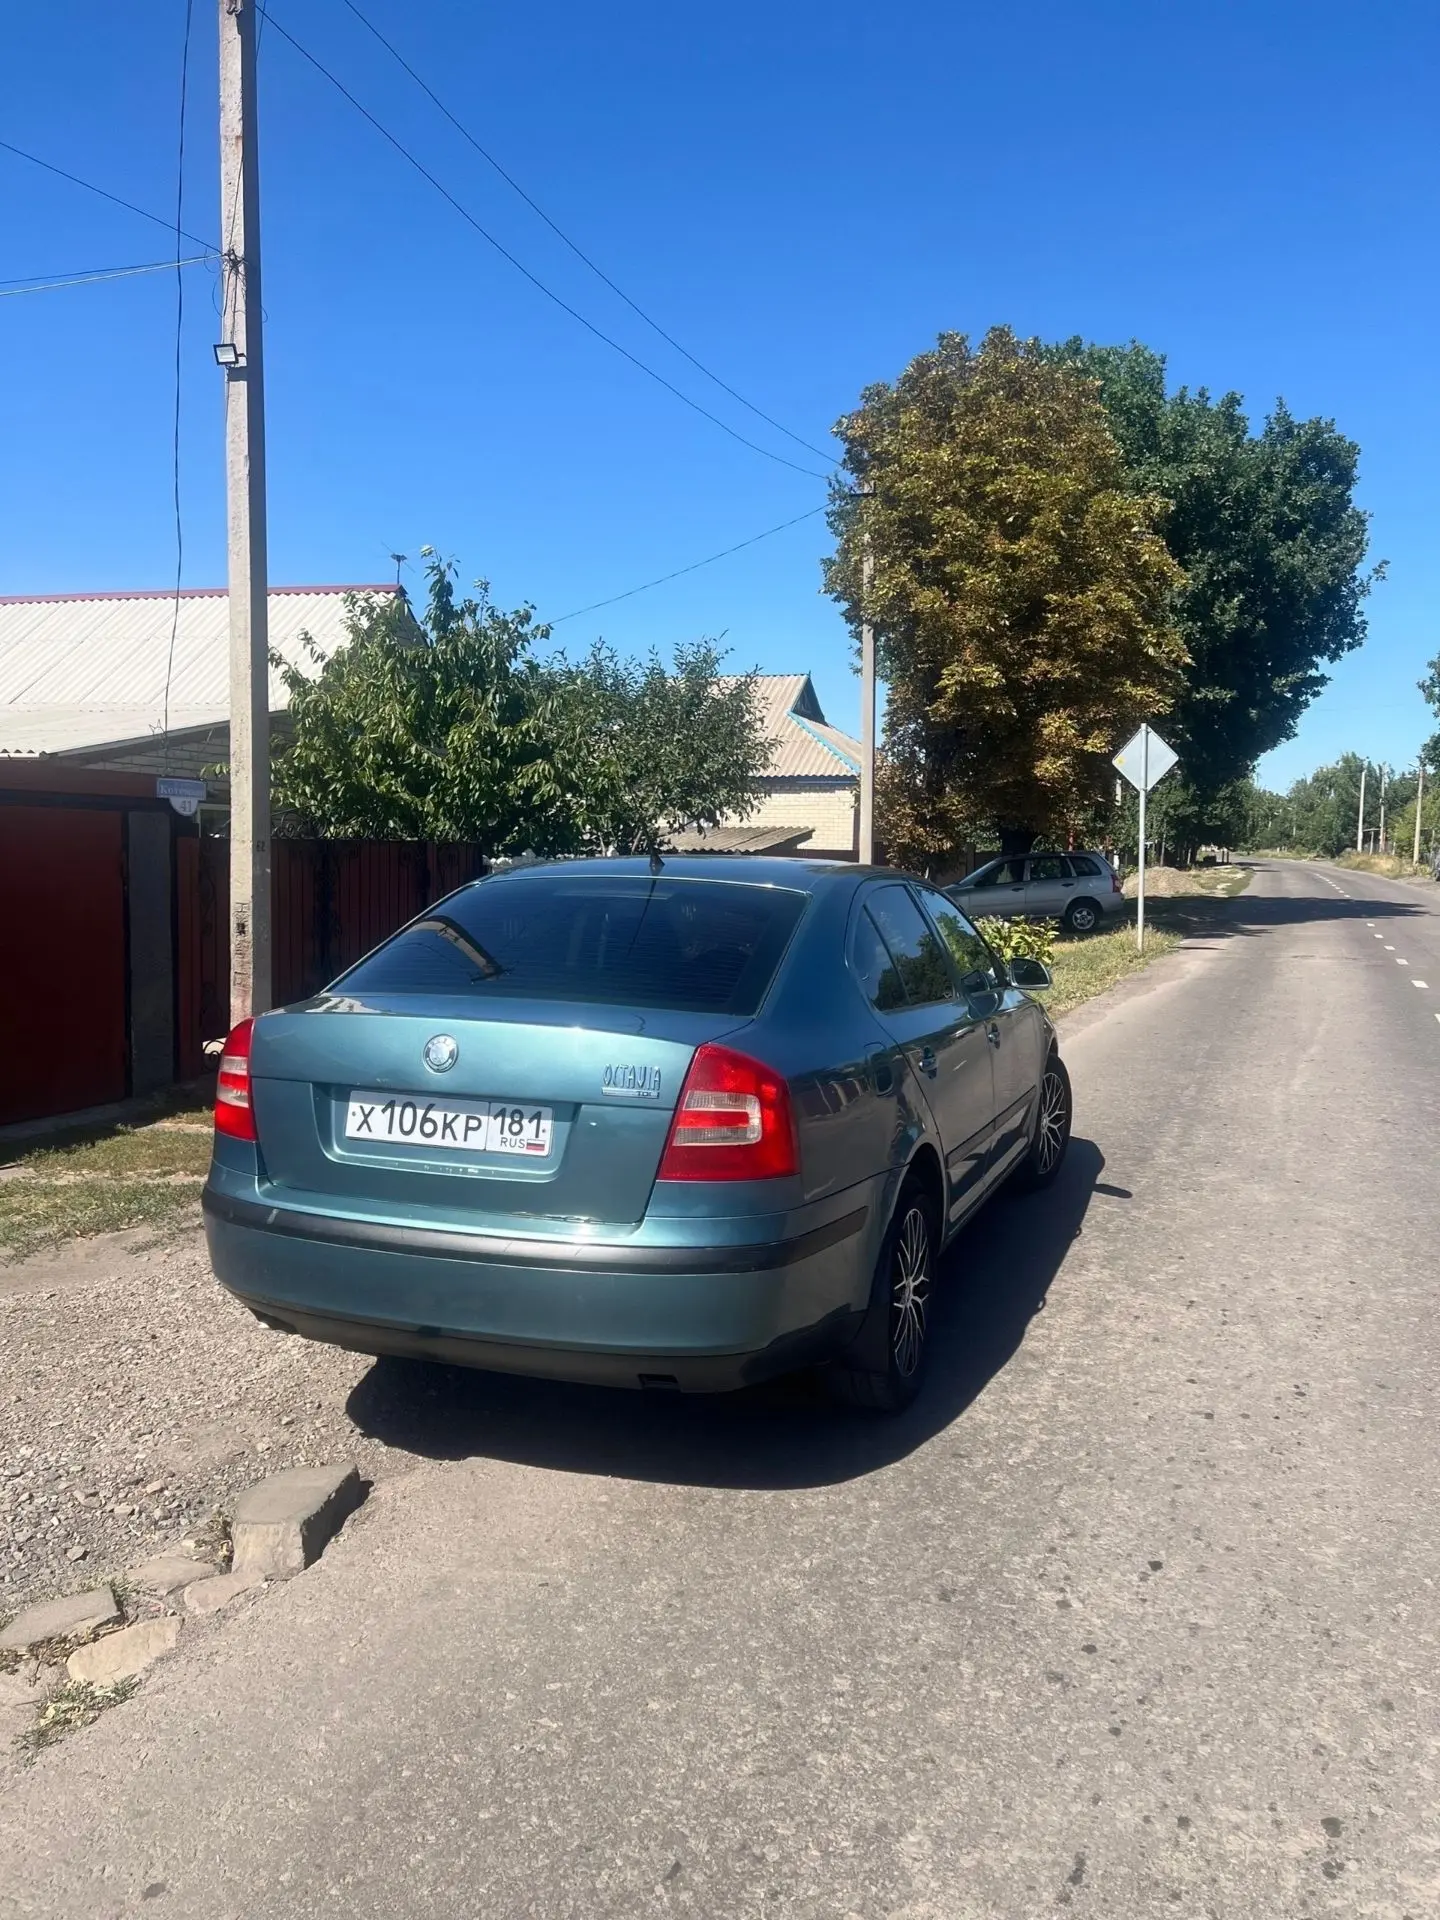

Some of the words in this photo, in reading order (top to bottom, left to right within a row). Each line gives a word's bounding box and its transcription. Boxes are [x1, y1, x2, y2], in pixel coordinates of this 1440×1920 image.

[603, 1064, 661, 1091] OCTAVIA
[493, 1107, 543, 1139] 181
[500, 1136, 526, 1149] RUS
